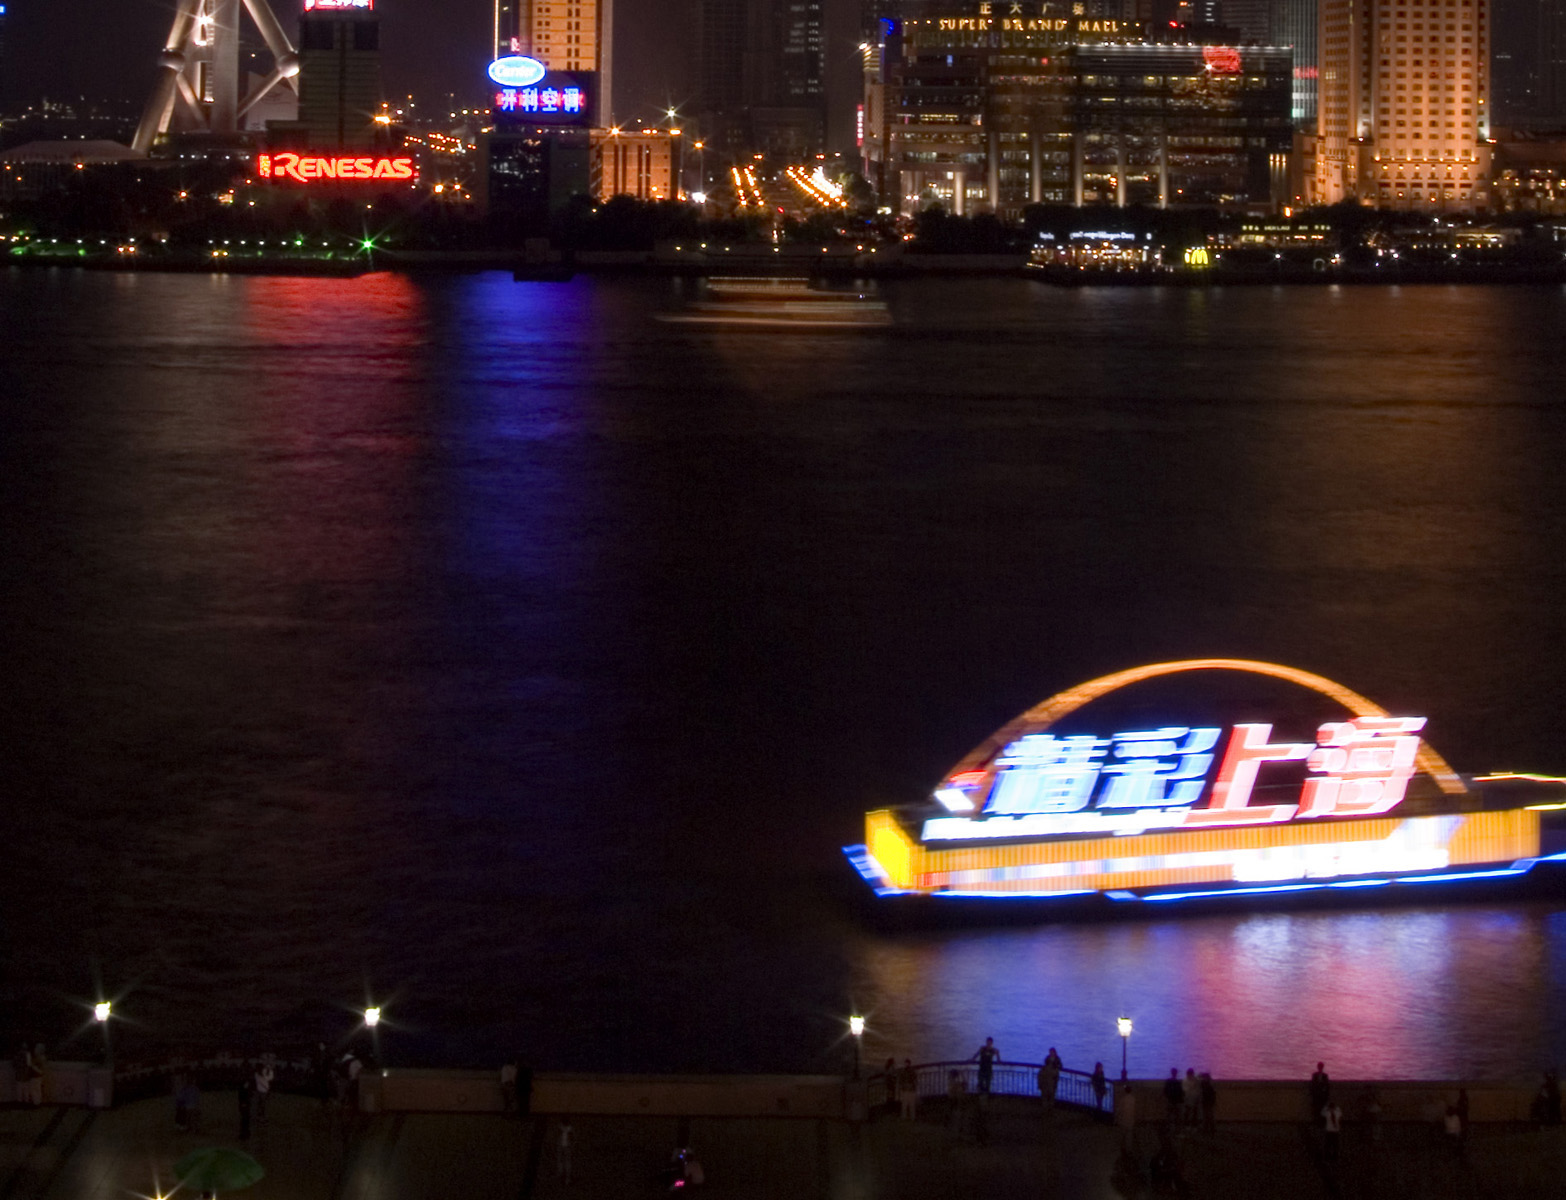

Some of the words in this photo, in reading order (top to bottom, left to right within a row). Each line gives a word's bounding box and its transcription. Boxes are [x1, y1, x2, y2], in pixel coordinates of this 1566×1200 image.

[980, 1, 1085, 15] 正大广场
[939, 19, 988, 31] SUPER
[1003, 19, 1066, 31] BRAND
[1079, 20, 1119, 33] MALL
[501, 87, 580, 112] 开利空调
[273, 152, 413, 183] RENESAS
